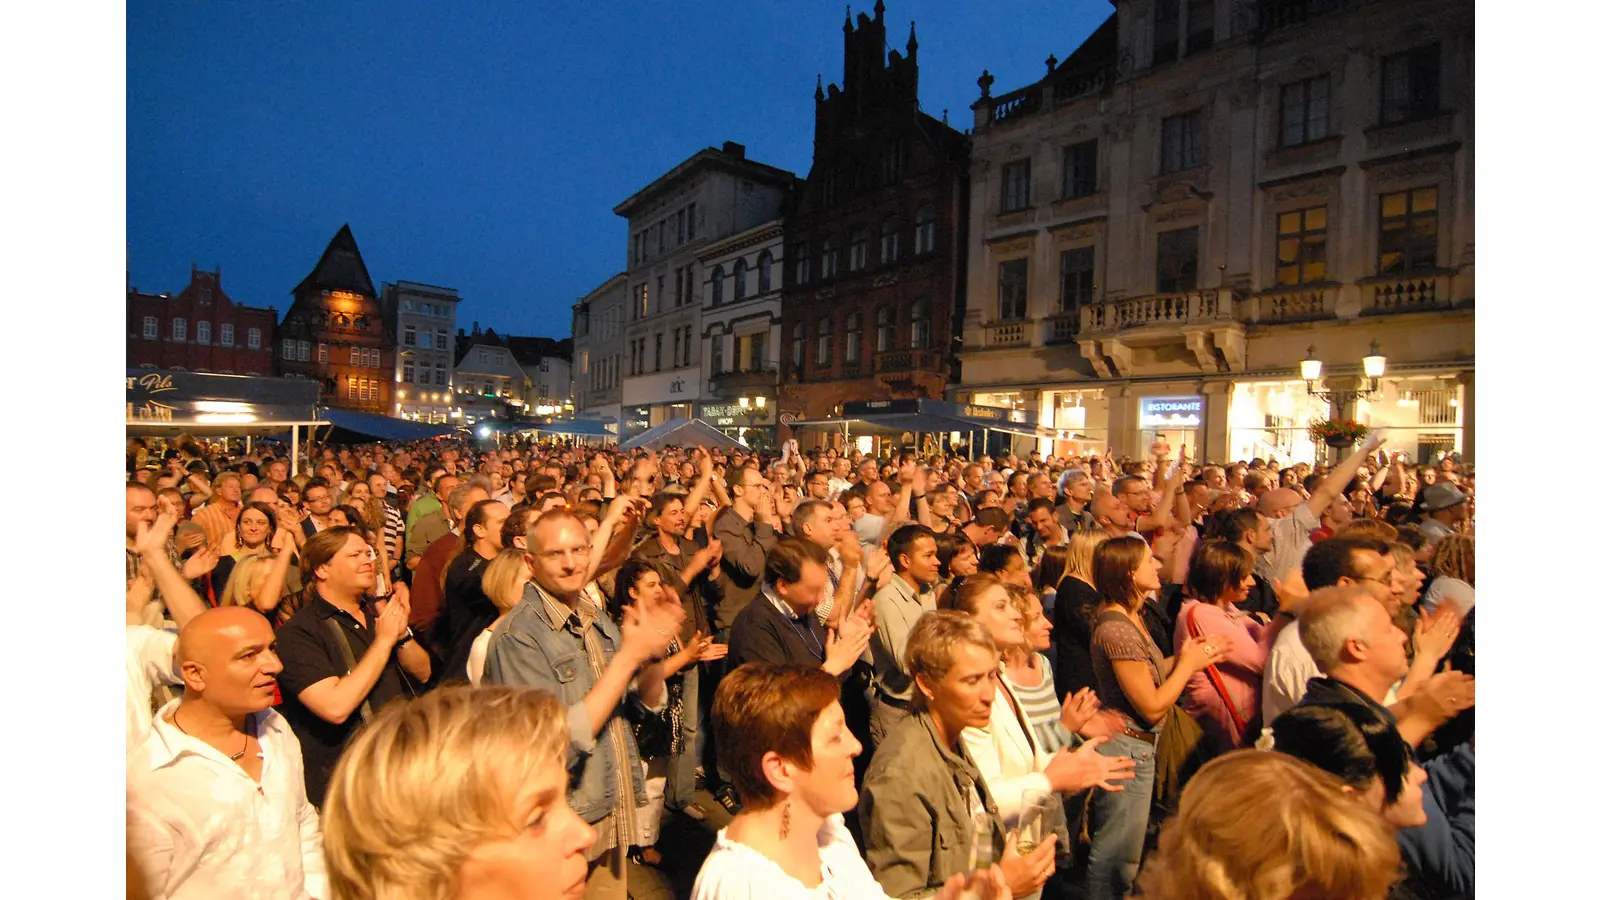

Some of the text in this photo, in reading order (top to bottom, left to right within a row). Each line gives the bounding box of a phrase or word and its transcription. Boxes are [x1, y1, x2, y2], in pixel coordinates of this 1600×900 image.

[126, 374, 174, 391] r Pils
[1147, 402, 1201, 411] RISTORANTE
